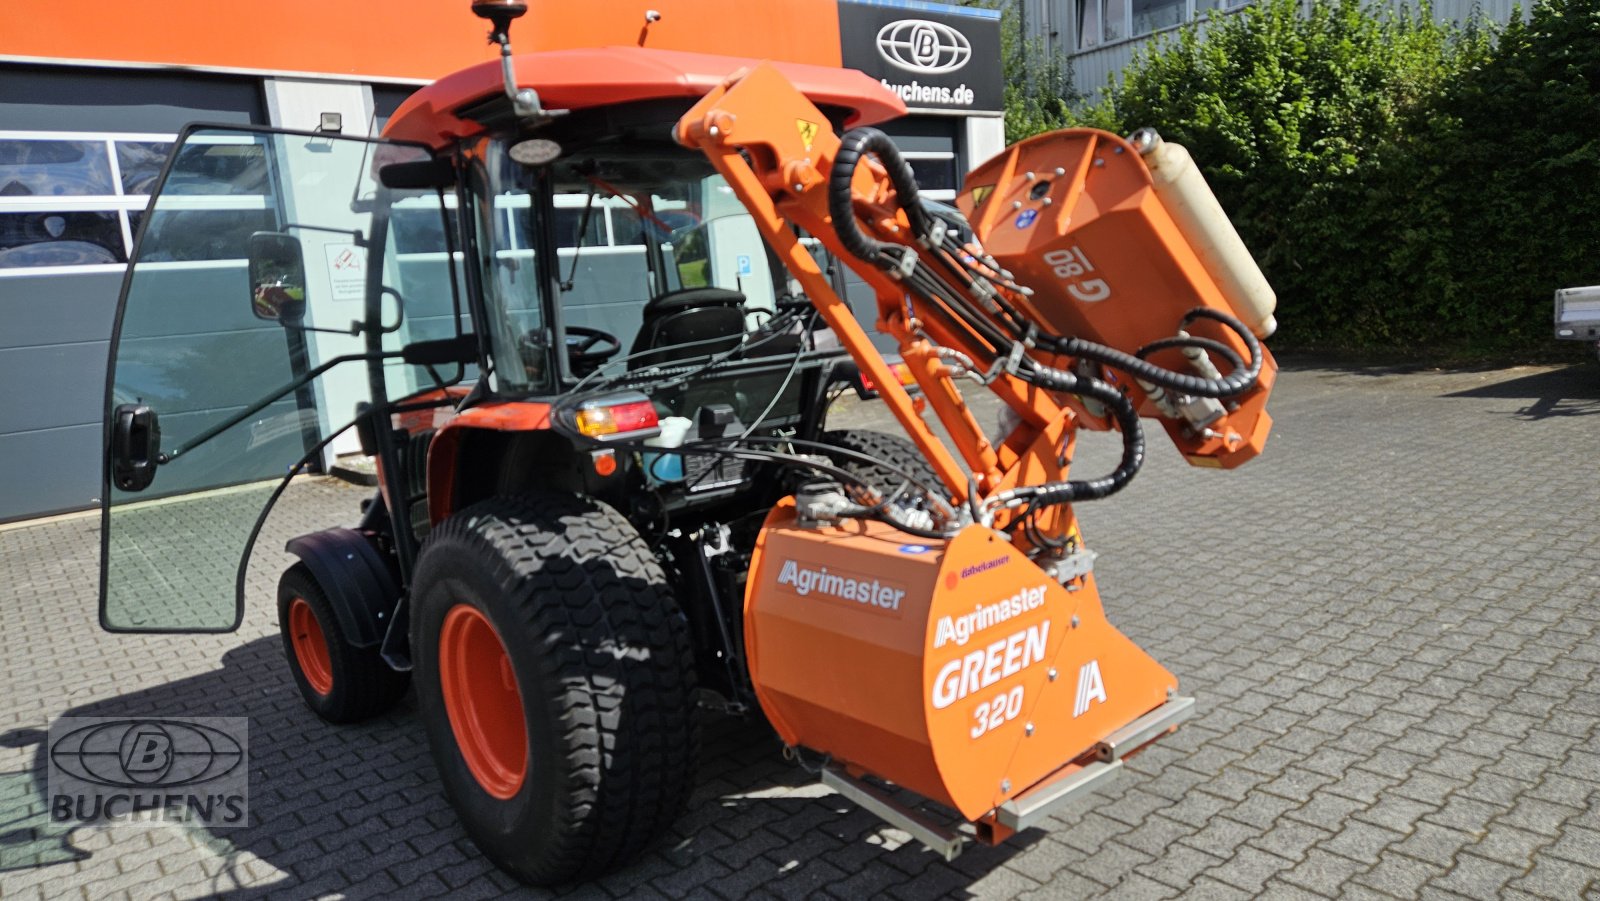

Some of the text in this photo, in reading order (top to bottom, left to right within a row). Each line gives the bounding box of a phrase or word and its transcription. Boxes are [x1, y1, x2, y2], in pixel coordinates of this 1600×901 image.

[1066, 278, 1111, 303] G
[777, 559, 906, 611] Agrimaster
[933, 584, 1048, 649] Agrimaster
[931, 619, 1051, 710] GREEN
[970, 684, 1025, 740] 320
